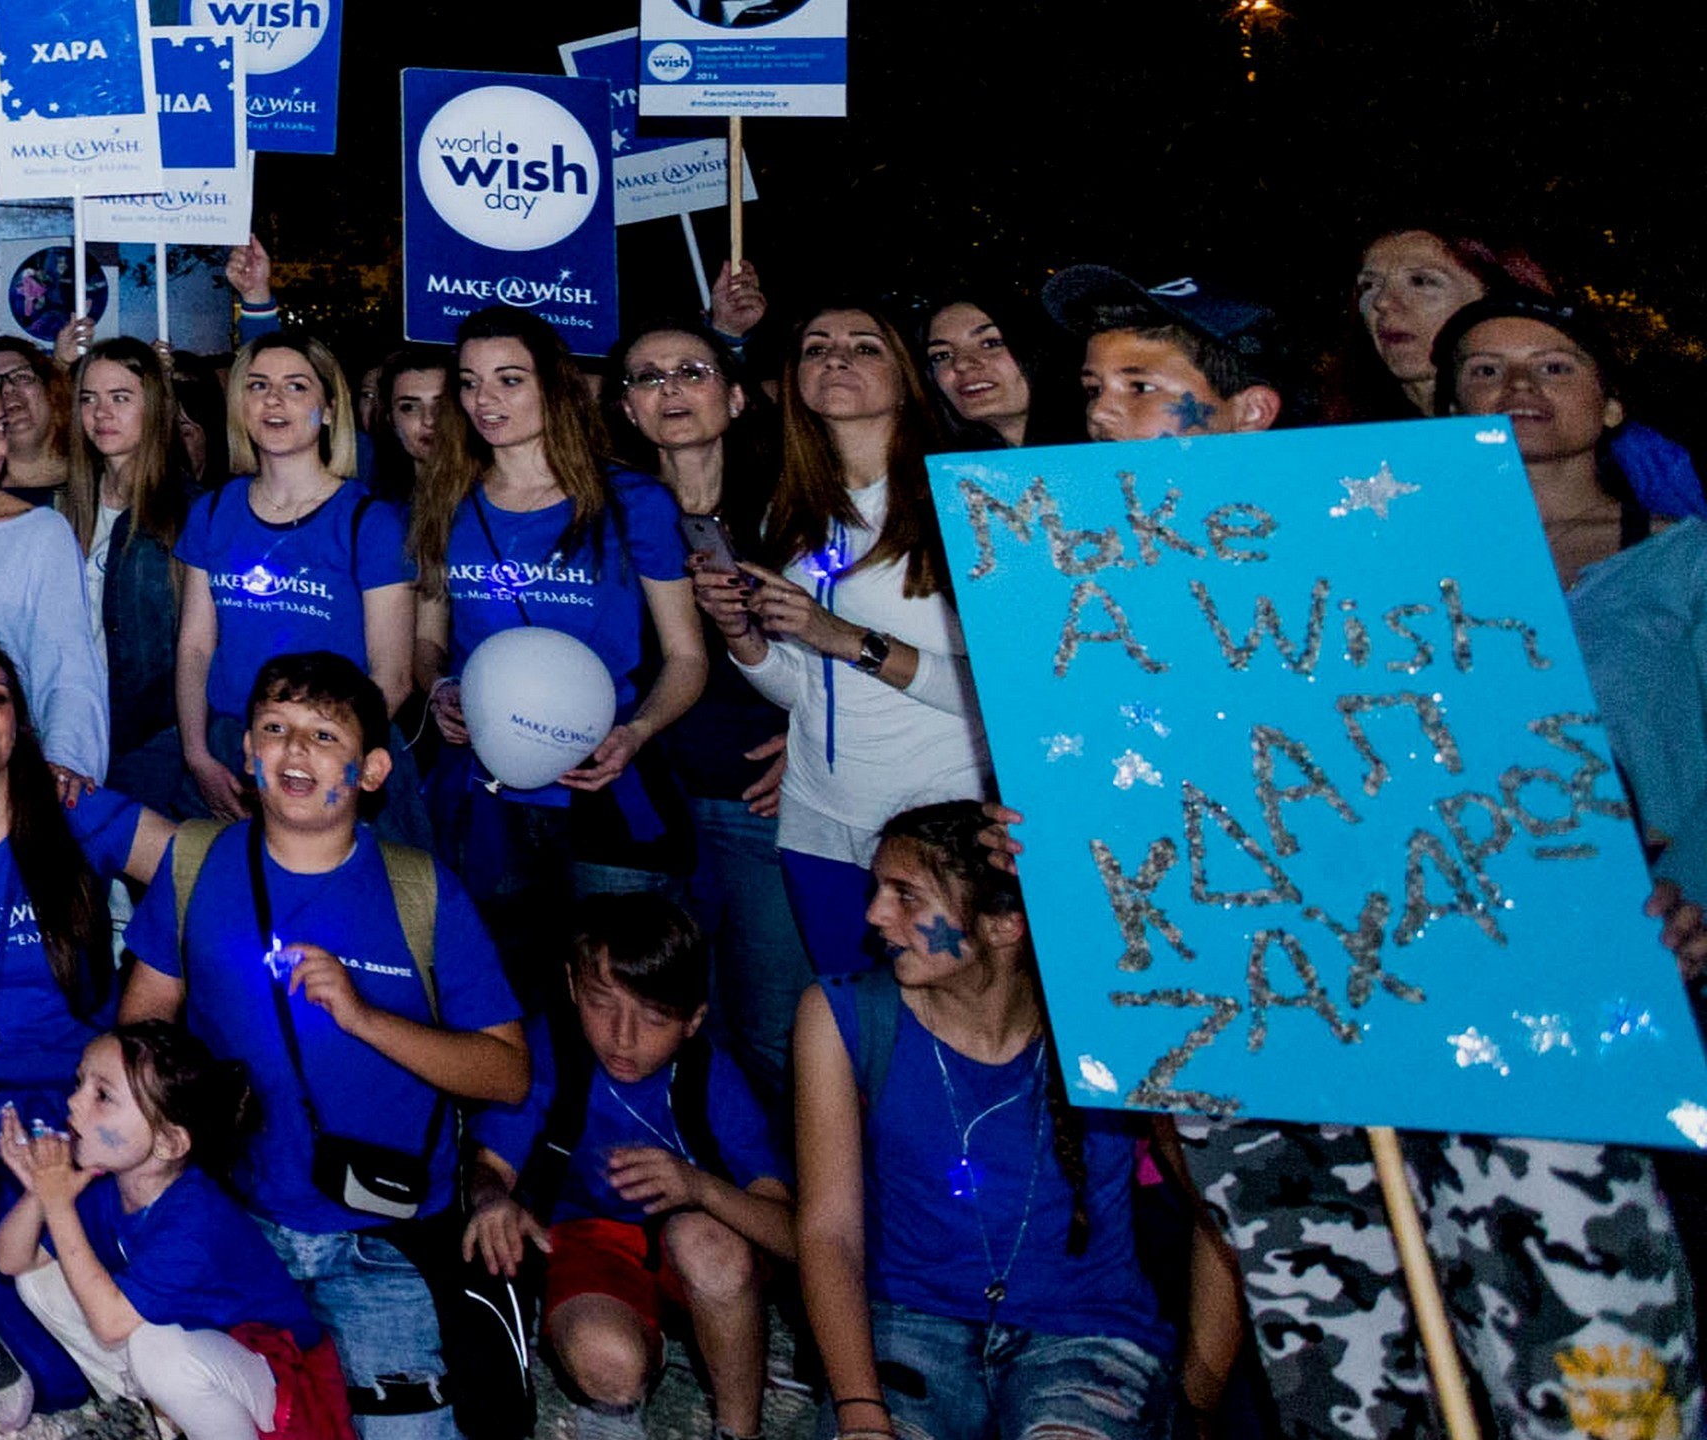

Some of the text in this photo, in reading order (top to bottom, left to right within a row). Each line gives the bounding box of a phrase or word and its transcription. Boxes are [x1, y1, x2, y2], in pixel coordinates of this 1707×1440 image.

[31, 39, 109, 64] ΧΑΡΑ
[653, 55, 691, 68] wish
[436, 130, 502, 154] world
[441, 142, 588, 195] wish
[484, 183, 539, 220] day
[958, 471, 1278, 583] Make
[1054, 576, 1553, 679] A Wish
[1090, 691, 1466, 973] ΚΔΑΠ
